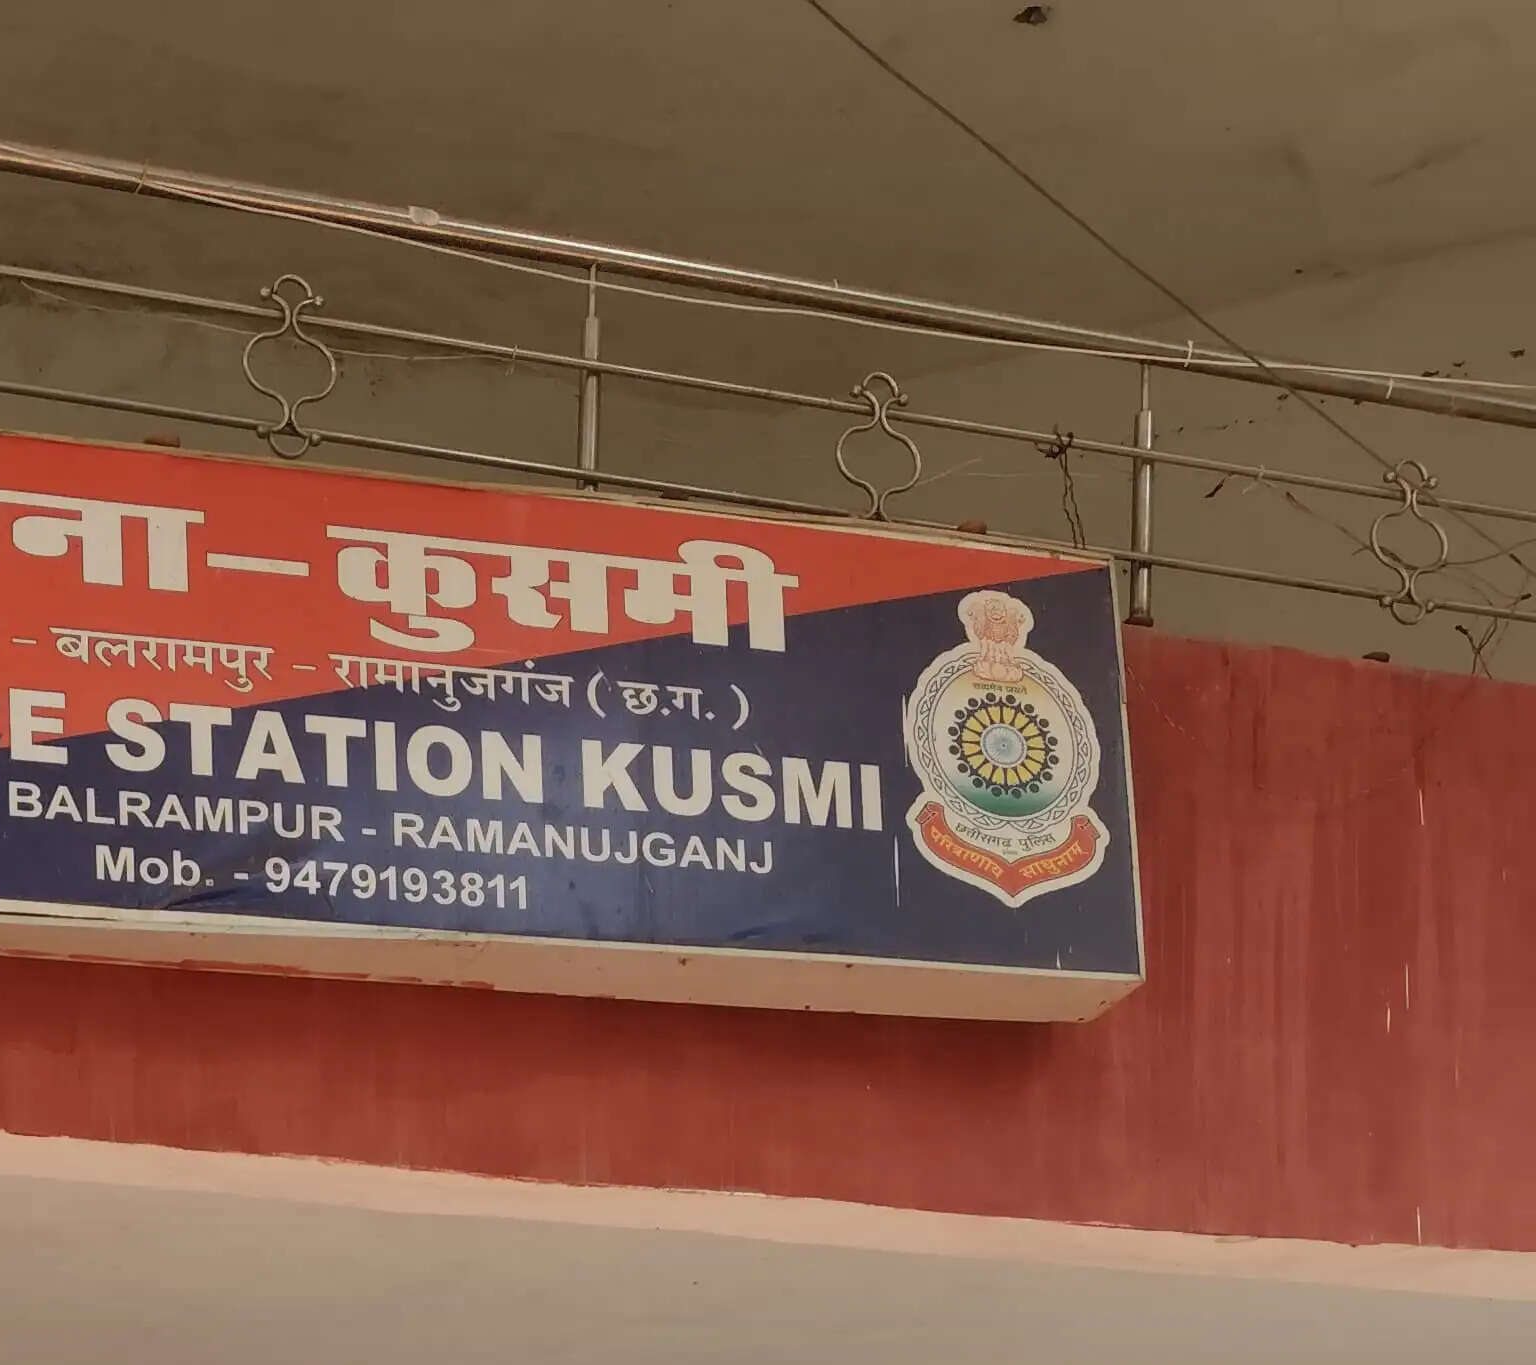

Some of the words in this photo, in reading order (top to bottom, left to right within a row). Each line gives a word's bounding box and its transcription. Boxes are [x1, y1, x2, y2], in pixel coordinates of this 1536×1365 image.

[48, 624, 275, 695] बलरामपुर
[328, 652, 574, 712] रामानुजगंज
[106, 696, 546, 805] STATION
[581, 735, 884, 831] KUSMI
[8, 780, 344, 843] BALRAMPUR
[393, 813, 775, 875] RAMANUJGANJ
[1018, 833, 1056, 851] पुलिस
[94, 843, 215, 888] Mob.
[264, 858, 529, 911] 9479193811
